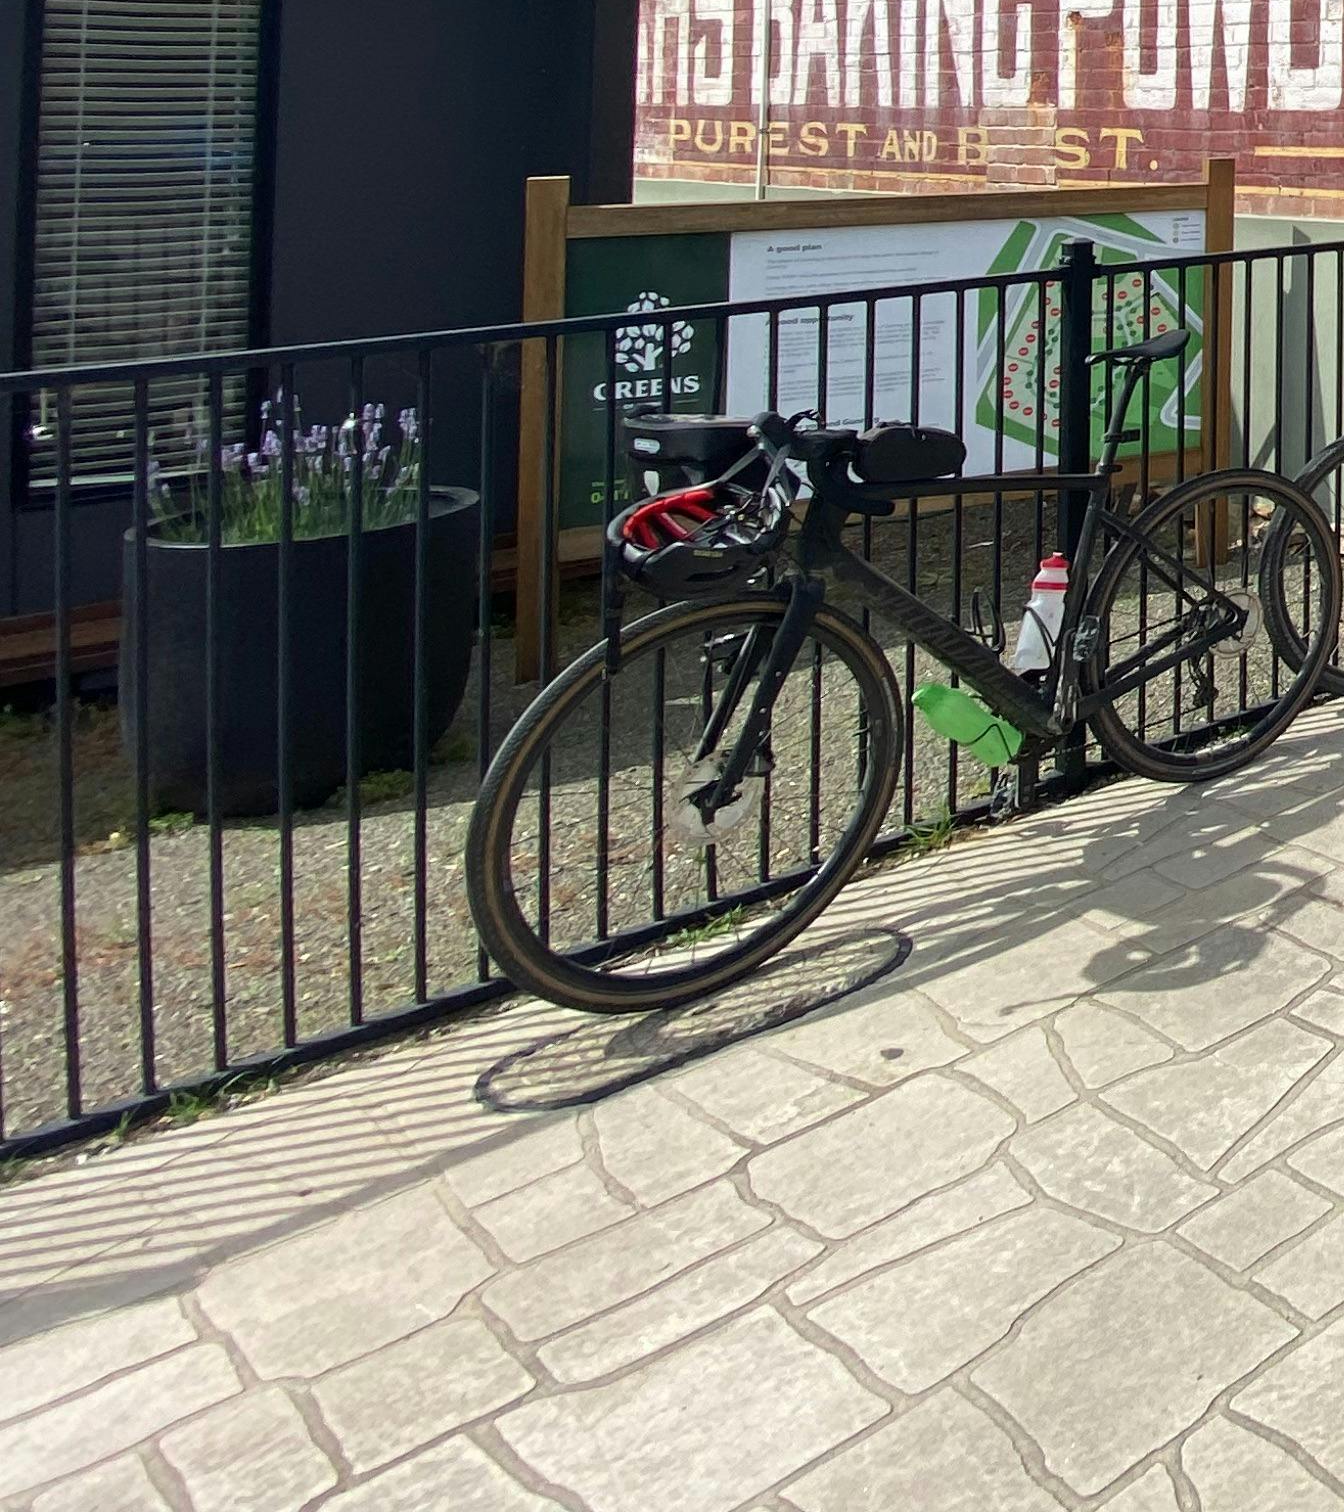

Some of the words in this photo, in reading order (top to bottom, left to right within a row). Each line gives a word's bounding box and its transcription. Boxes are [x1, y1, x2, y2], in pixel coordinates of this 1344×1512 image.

[668, 118, 868, 157] PUREST
[880, 129, 939, 162] AND
[958, 126, 1159, 172] BST.
